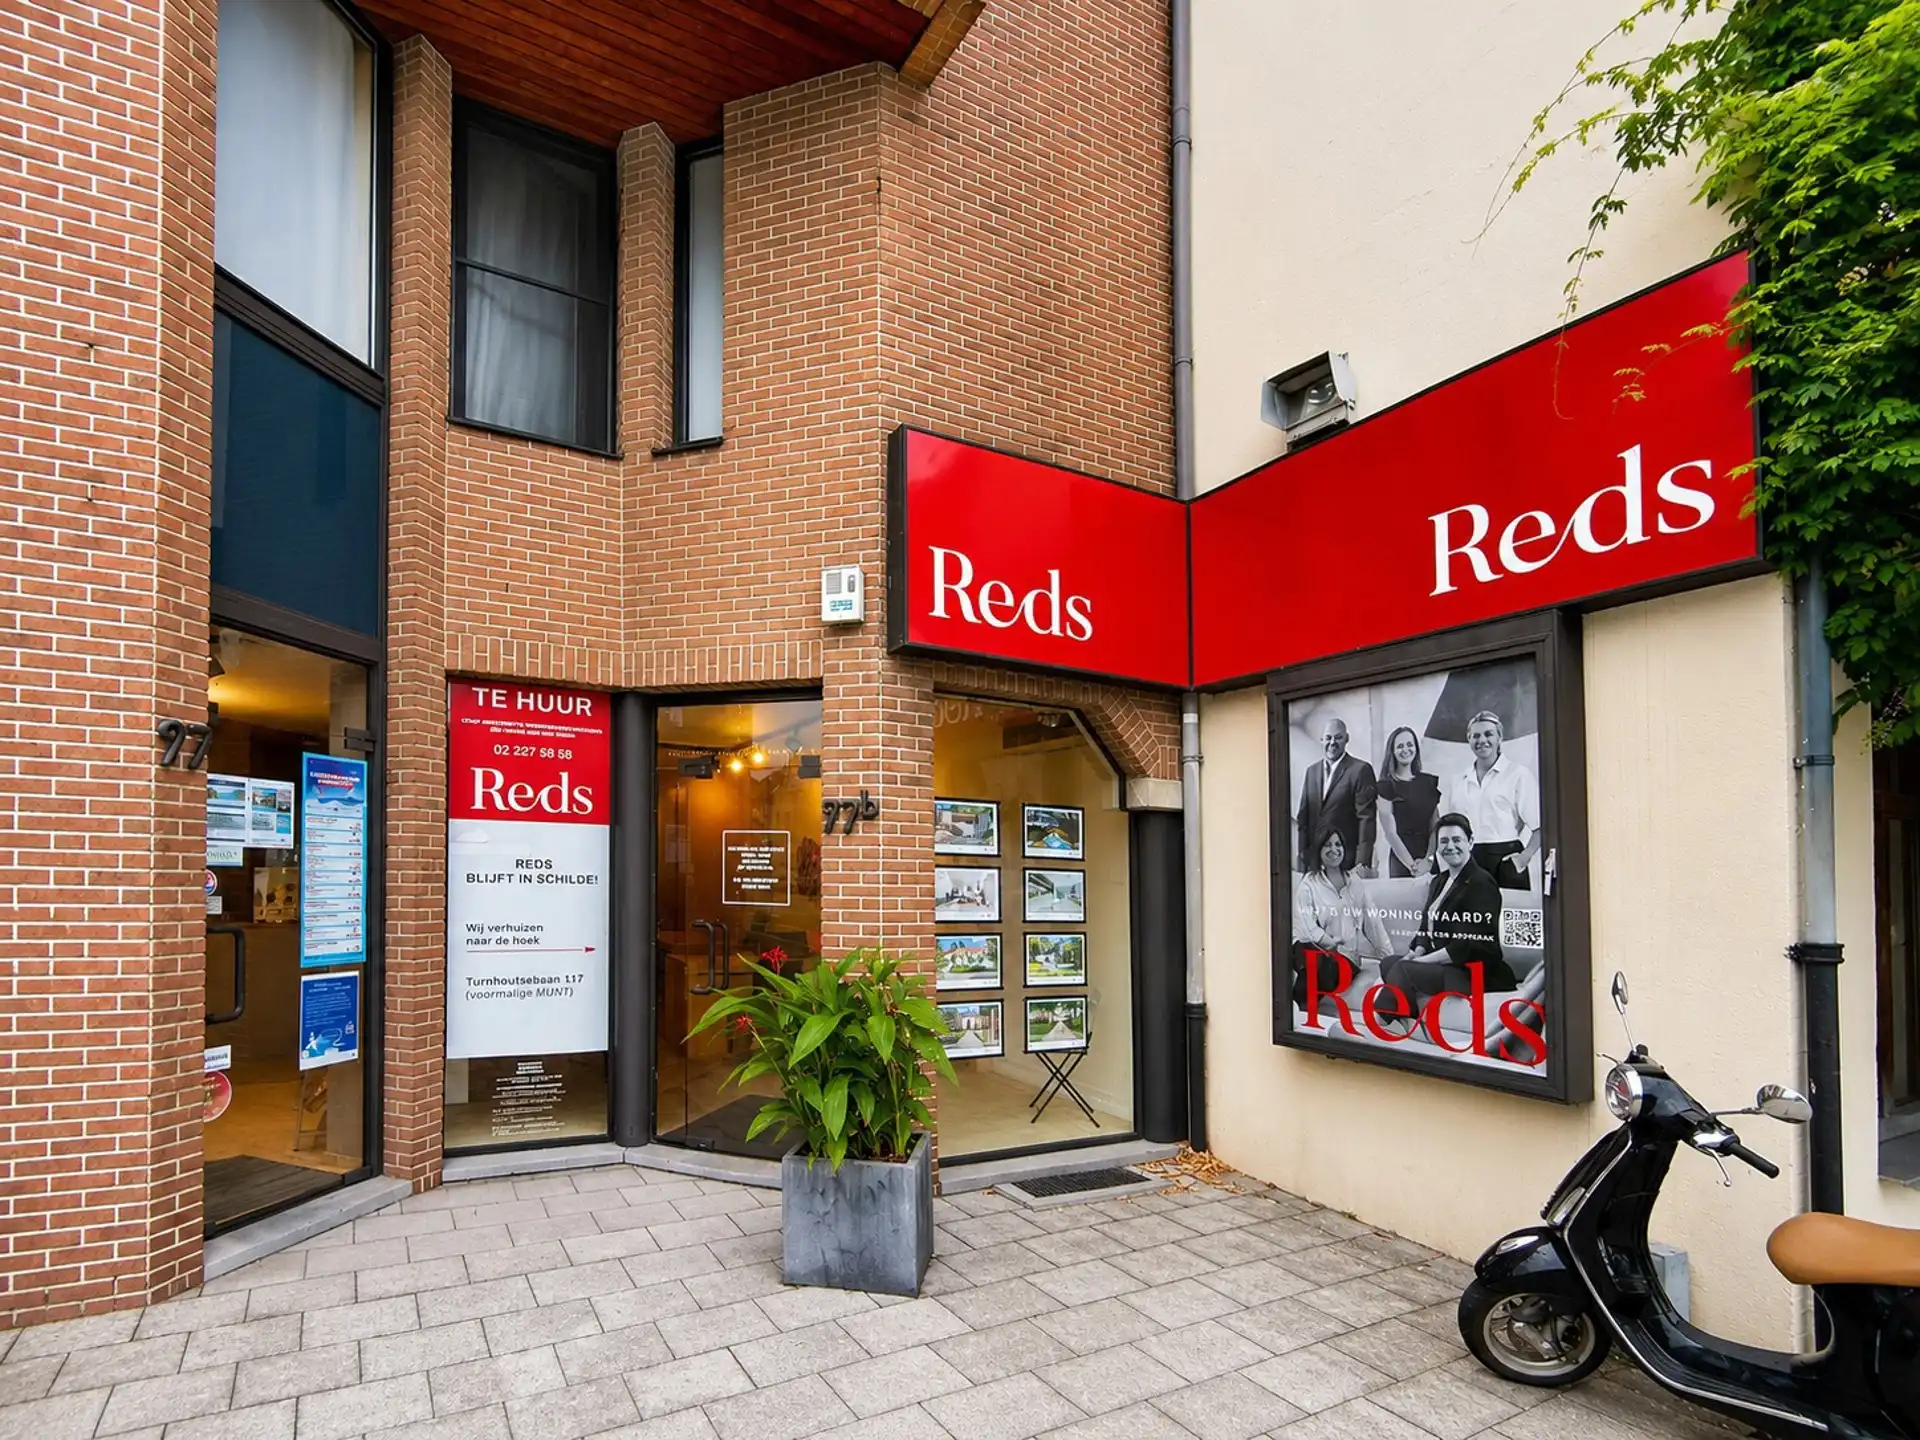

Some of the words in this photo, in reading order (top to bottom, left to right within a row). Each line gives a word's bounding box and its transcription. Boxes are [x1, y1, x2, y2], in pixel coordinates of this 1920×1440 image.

[1427, 443, 1716, 598] Reds
[928, 545, 1094, 642] Reds
[472, 686, 508, 709] TE
[516, 691, 593, 717] HUUR
[158, 719, 213, 770] 97
[493, 744, 510, 756] 02
[513, 745, 537, 757] 227
[470, 766, 594, 816] Reds
[515, 858, 553, 870] REDS
[465, 873, 515, 885] BLIJFT
[518, 873, 533, 885] IN
[536, 873, 599, 886] SCHILDE!
[1343, 906, 1363, 918] UW
[1366, 907, 1424, 921] WONING
[1428, 910, 1493, 924] WAARD?
[465, 923, 485, 935] Wij
[487, 922, 544, 933] verhuizen
[465, 937, 493, 946] naar
[495, 936, 511, 946] de
[512, 935, 541, 946] hoek
[465, 974, 561, 987] Turnhoutsebaan
[565, 973, 584, 984] 117
[465, 987, 533, 1001] (voormalige
[535, 986, 574, 998] MUNT)
[1300, 948, 1548, 1067] Reds
